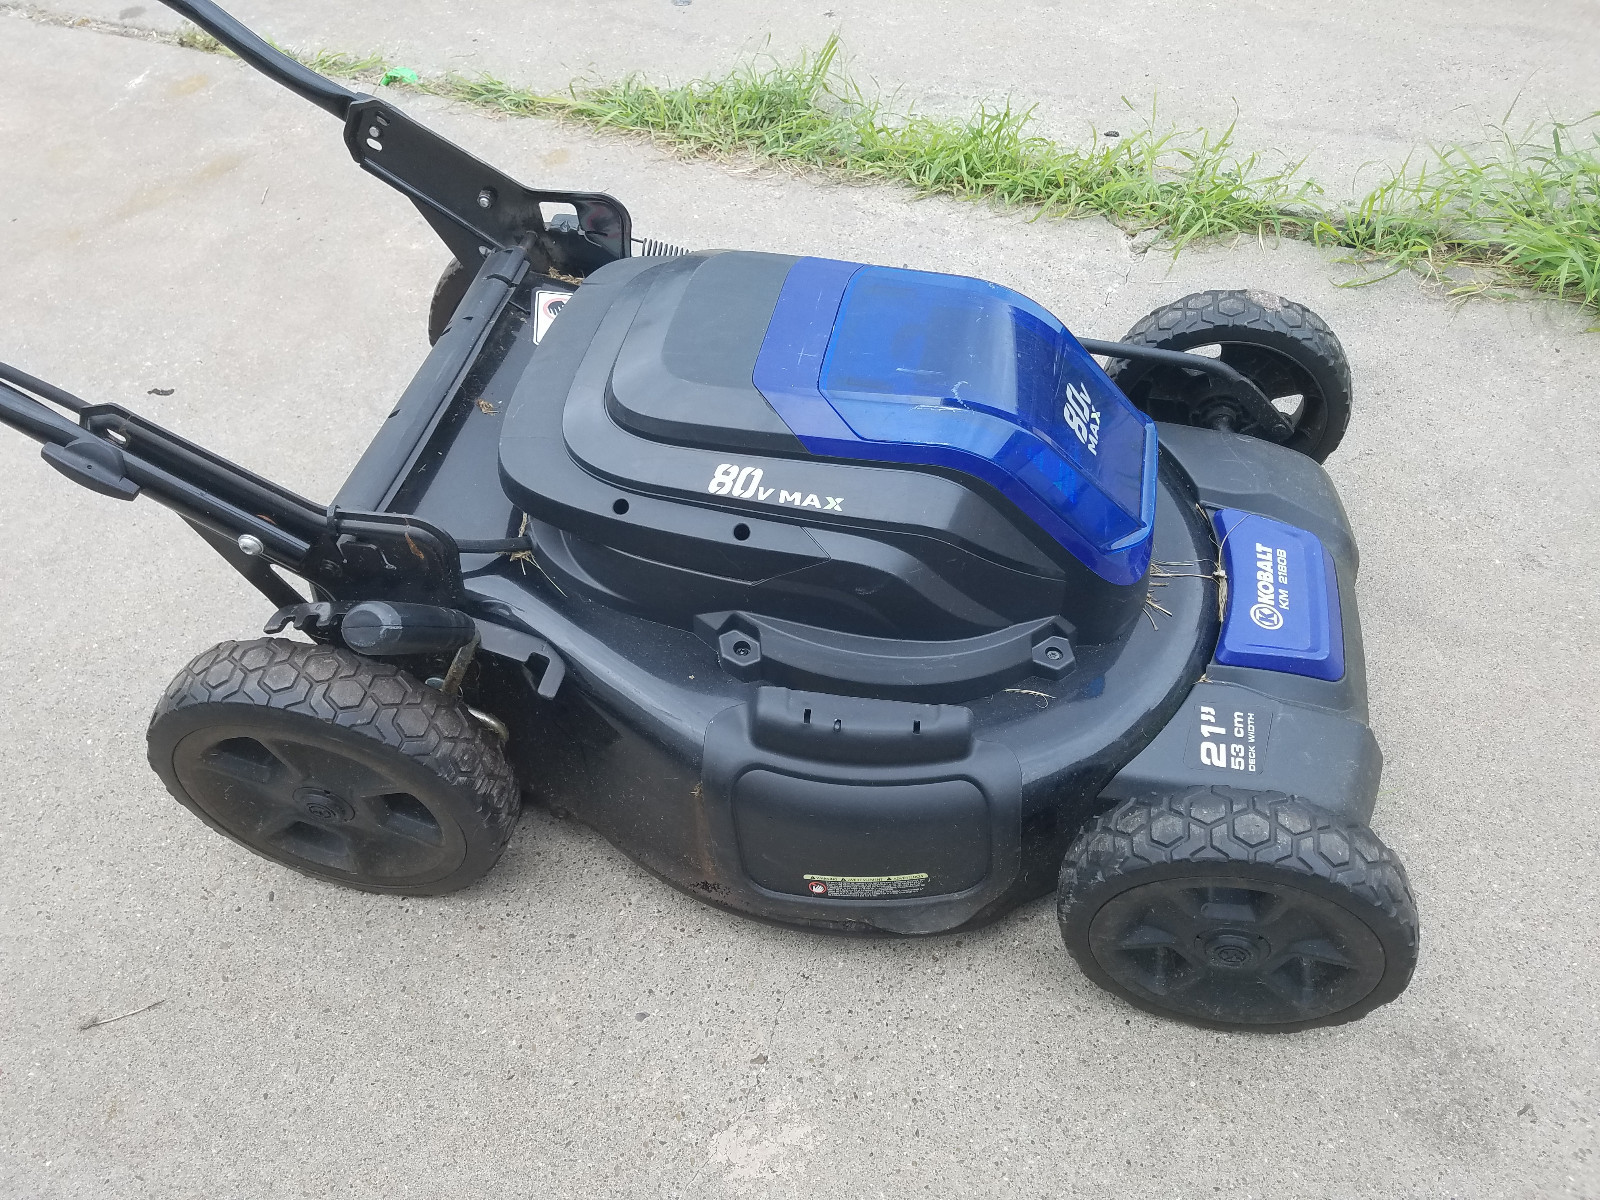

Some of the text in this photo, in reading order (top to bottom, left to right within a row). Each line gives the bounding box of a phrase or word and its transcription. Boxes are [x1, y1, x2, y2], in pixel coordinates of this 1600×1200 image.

[1087, 404, 1101, 457] MAX
[778, 489, 845, 512] MAX
[1255, 542, 1275, 606] KOBALT
[1276, 548, 1290, 611] KM 2180B
[1230, 711, 1245, 771] 53 cm
[1247, 712, 1256, 772] DECK WIDTH
